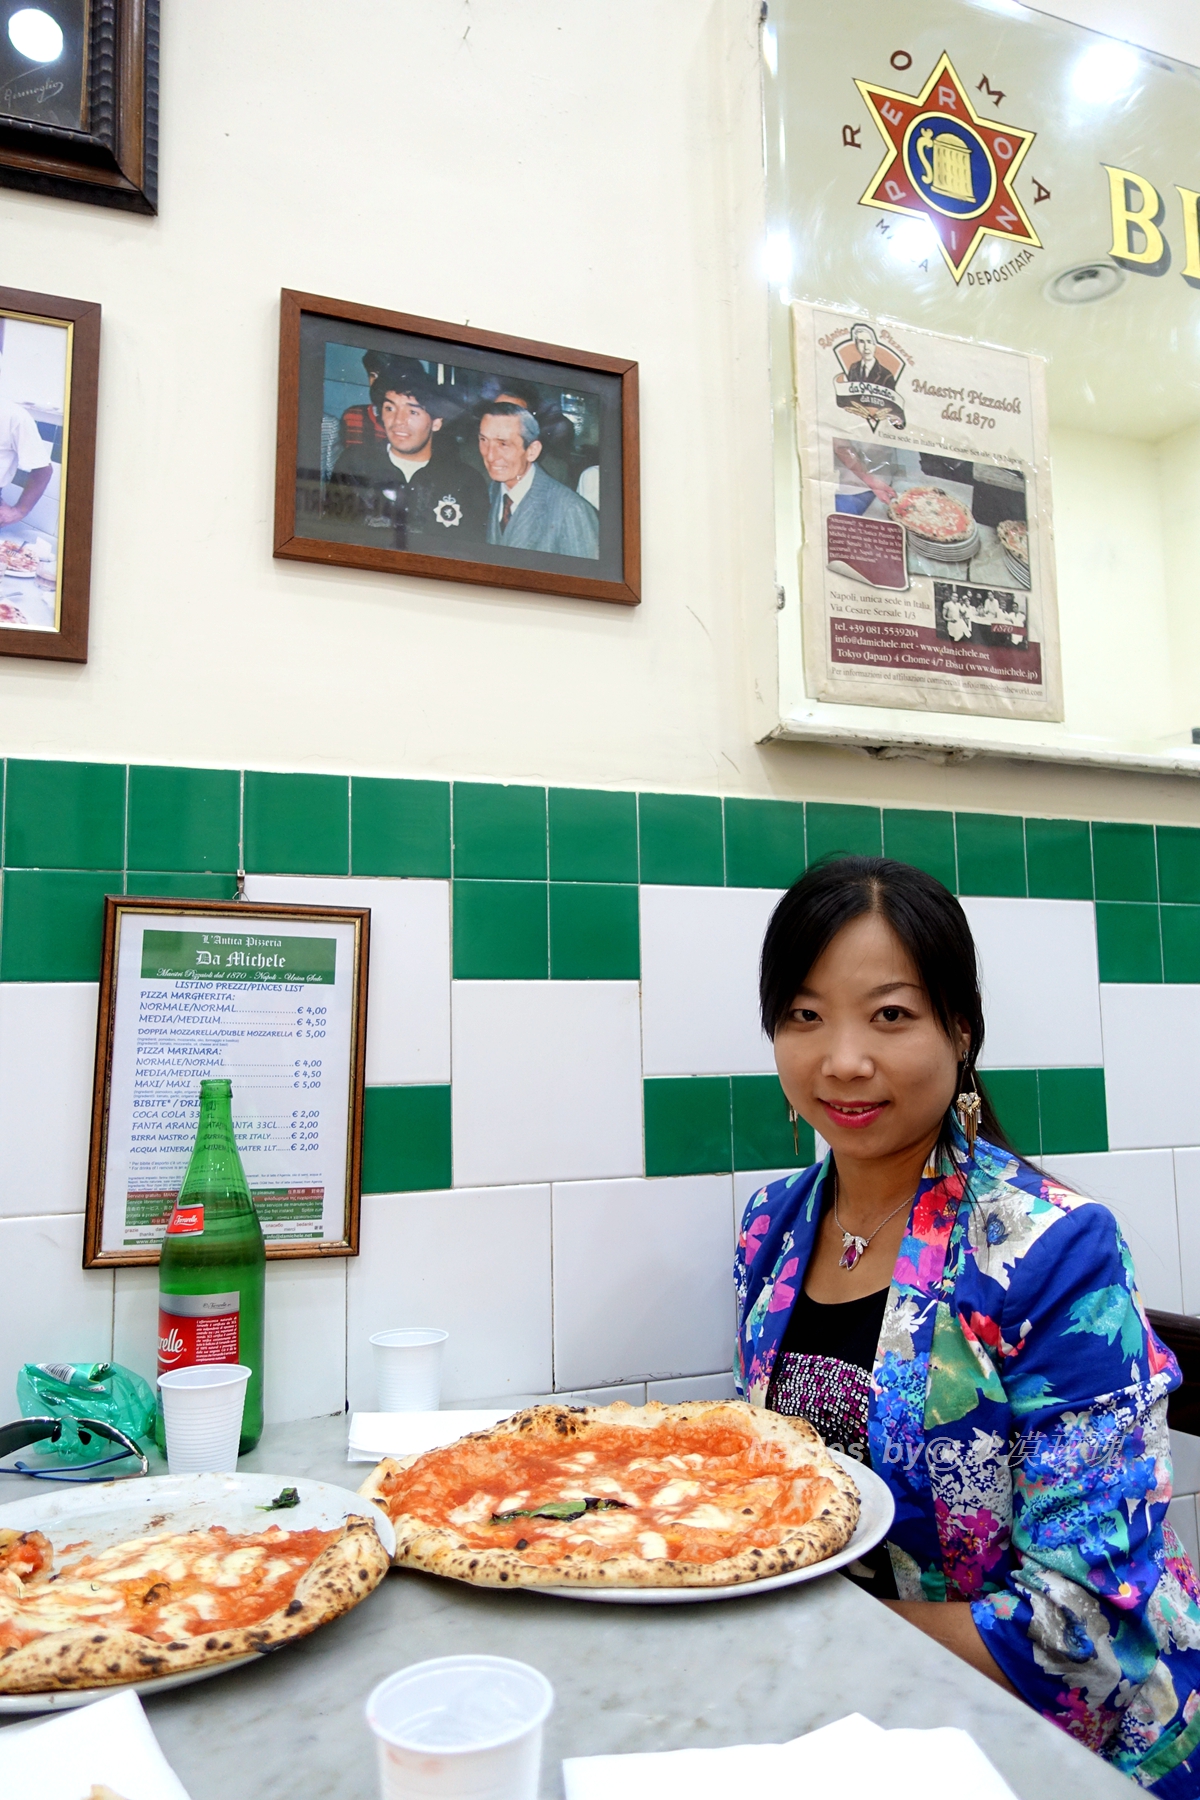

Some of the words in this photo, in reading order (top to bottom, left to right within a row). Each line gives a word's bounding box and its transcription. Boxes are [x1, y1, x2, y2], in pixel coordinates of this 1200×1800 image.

[966, 249, 1034, 286] DEPOSITATA
[911, 379, 965, 401] Maestri
[967, 390, 1021, 414] Pizzaioli
[941, 403, 965, 422] dal
[966, 412, 996, 429] 1870
[884, 597, 902, 605] sede
[904, 599, 911, 607] in
[830, 603, 843, 612] Via
[845, 605, 871, 615] Cesare
[873, 608, 902, 617] Sersale
[904, 610, 916, 619] 1/3
[834, 623, 848, 631] tel.
[849, 624, 864, 633] +39
[866, 625, 919, 637] 081.5539204
[834, 635, 914, 649] info@damichele.net
[920, 644, 990, 660] www.damichele.net
[837, 648, 861, 660] Tokyo
[863, 652, 892, 662] (Japan)
[894, 654, 899, 662] 4
[901, 654, 930, 665] Chome
[931, 658, 943, 667] 4/7
[945, 659, 963, 670] Ebisu
[965, 663, 1038, 680] (www.damichele.jp)
[202, 934, 242, 945] L'Antica
[245, 937, 282, 947] Pizzeria
[195, 950, 221, 965] Da
[225, 951, 286, 969] Michele
[175, 981, 213, 989] LISTINO
[215, 982, 283, 991] PREZZI/PINCES
[284, 984, 304, 992] LIST
[171, 992, 236, 1001] MARGHERITA:
[297, 1006, 304, 1014] €
[306, 1006, 327, 1015] 4,00
[138, 1014, 221, 1024] MEDIA/MEDIUM
[296, 1018, 303, 1026] €
[305, 1018, 327, 1027] 4,50
[170, 1029, 245, 1037] MOZZARELLA/DUBLE
[305, 1030, 326, 1038] 5,00
[136, 1046, 164, 1054] PIZZA
[167, 1047, 222, 1055] MARINARA:
[302, 1060, 322, 1068] 4,00
[135, 1069, 211, 1077] MEDIA/MEDIUM
[302, 1070, 322, 1078] 4,50
[134, 1080, 165, 1088] MAXI/
[165, 1080, 191, 1088] MAXI
[302, 1081, 321, 1089] 5,00
[292, 1110, 298, 1118] €
[300, 1110, 320, 1118] 2,00
[132, 1122, 163, 1130] FANTA
[256, 1121, 277, 1129] 33CL
[299, 1121, 319, 1129] 2,00
[299, 1132, 319, 1140] 2,00
[130, 1146, 157, 1154] ACQUA
[290, 1143, 297, 1151] €
[299, 1143, 319, 1151] 2,00
[158, 1329, 184, 1353] relle
